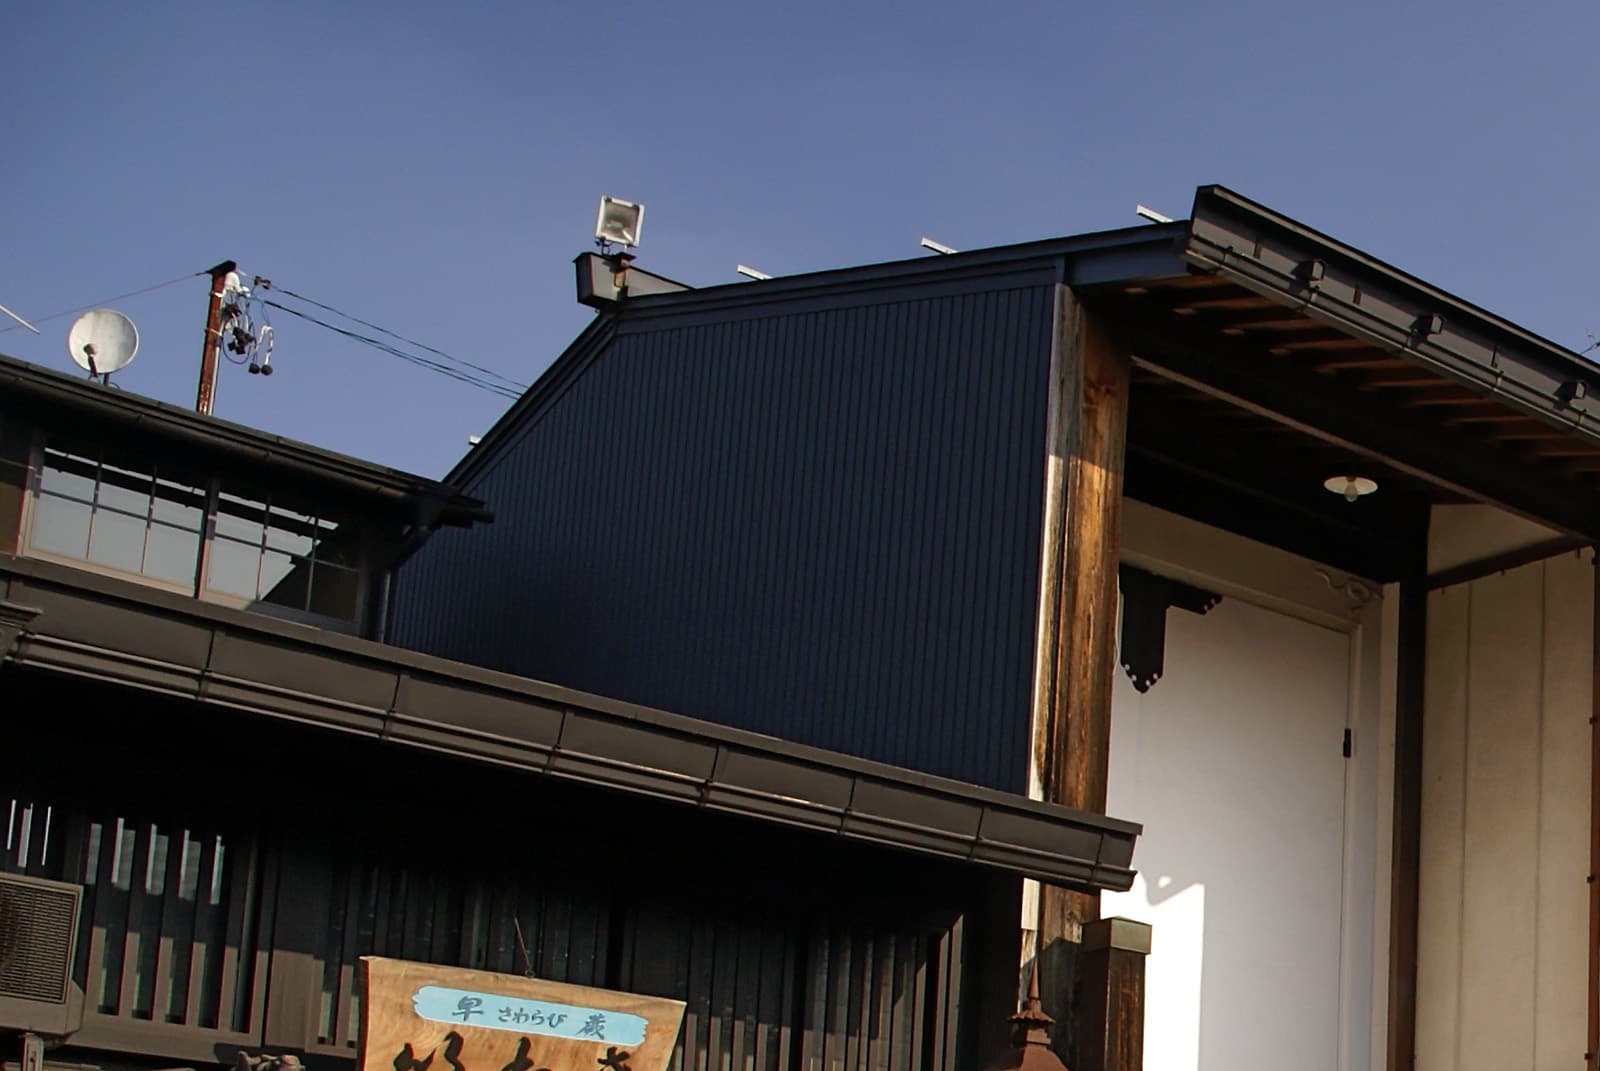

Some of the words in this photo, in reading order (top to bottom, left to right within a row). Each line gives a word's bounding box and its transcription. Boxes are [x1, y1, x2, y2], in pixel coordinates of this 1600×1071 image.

[452, 996, 484, 1021] 早
[498, 1007, 568, 1028] さわらび
